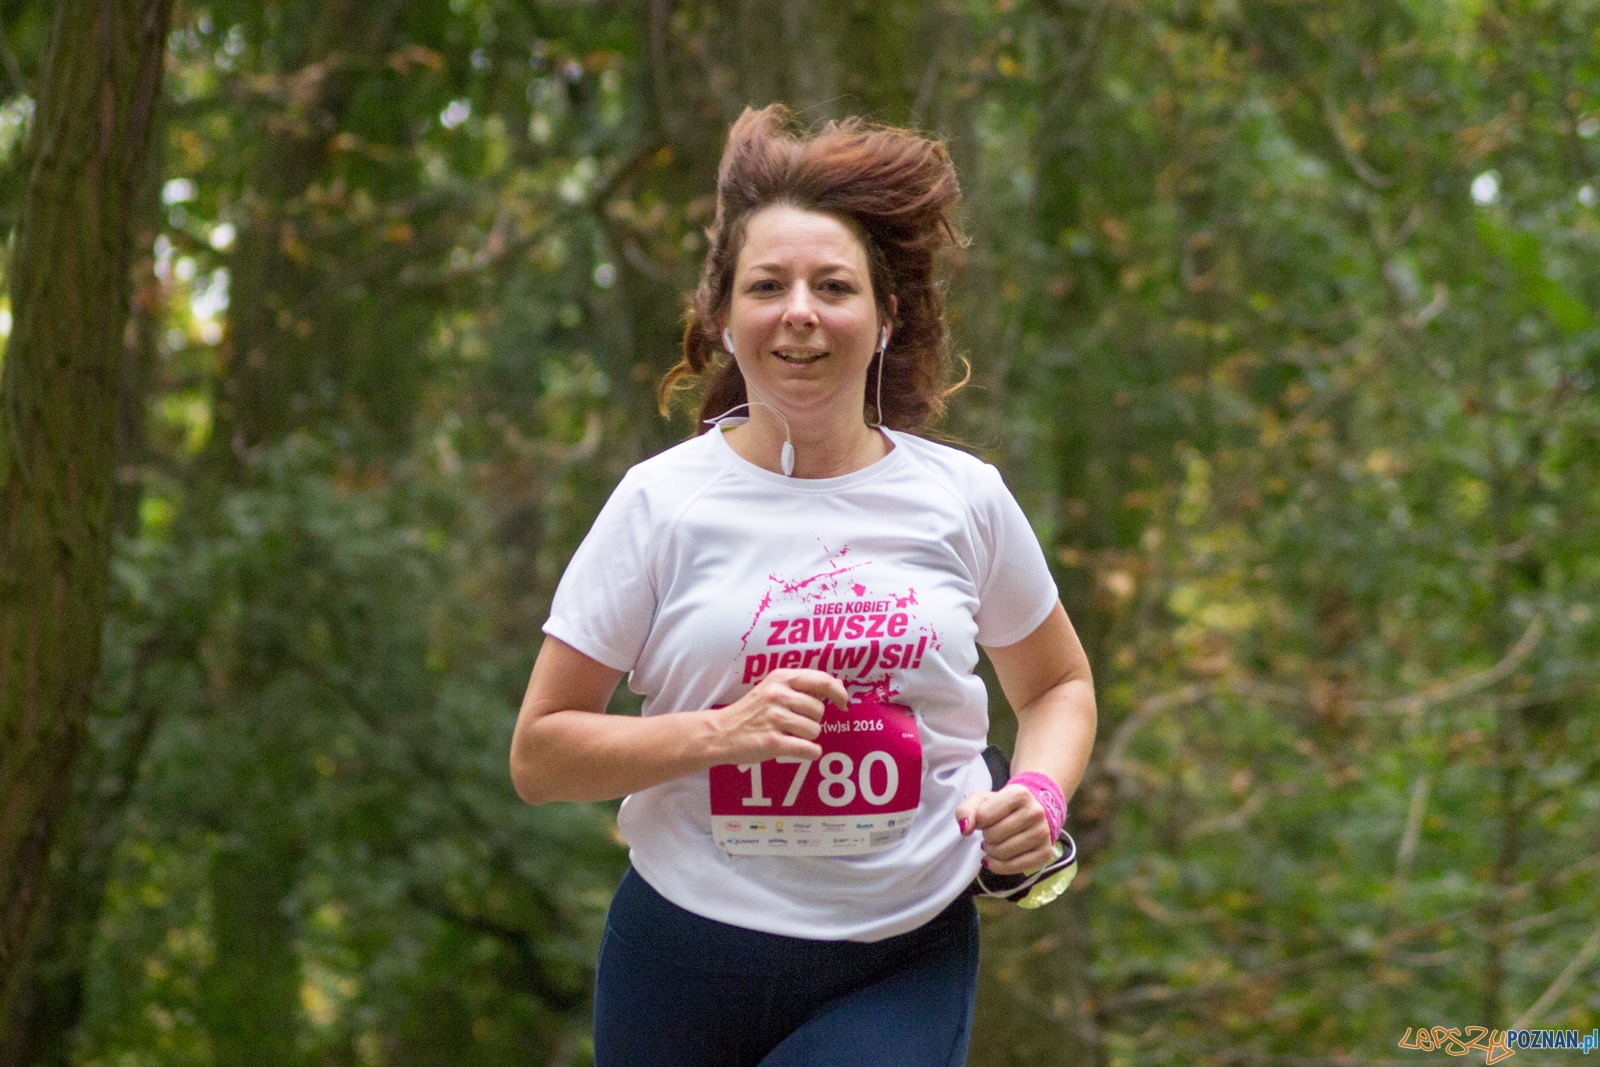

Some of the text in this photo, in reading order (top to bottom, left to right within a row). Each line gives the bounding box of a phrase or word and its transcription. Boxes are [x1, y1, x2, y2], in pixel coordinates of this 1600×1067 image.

[813, 600, 891, 615] BIEG KOBIET
[766, 612, 909, 647] zawsze
[742, 636, 928, 684] pier(w)si!
[820, 719, 884, 734] r(w)si 2016
[737, 750, 899, 807] 1780
